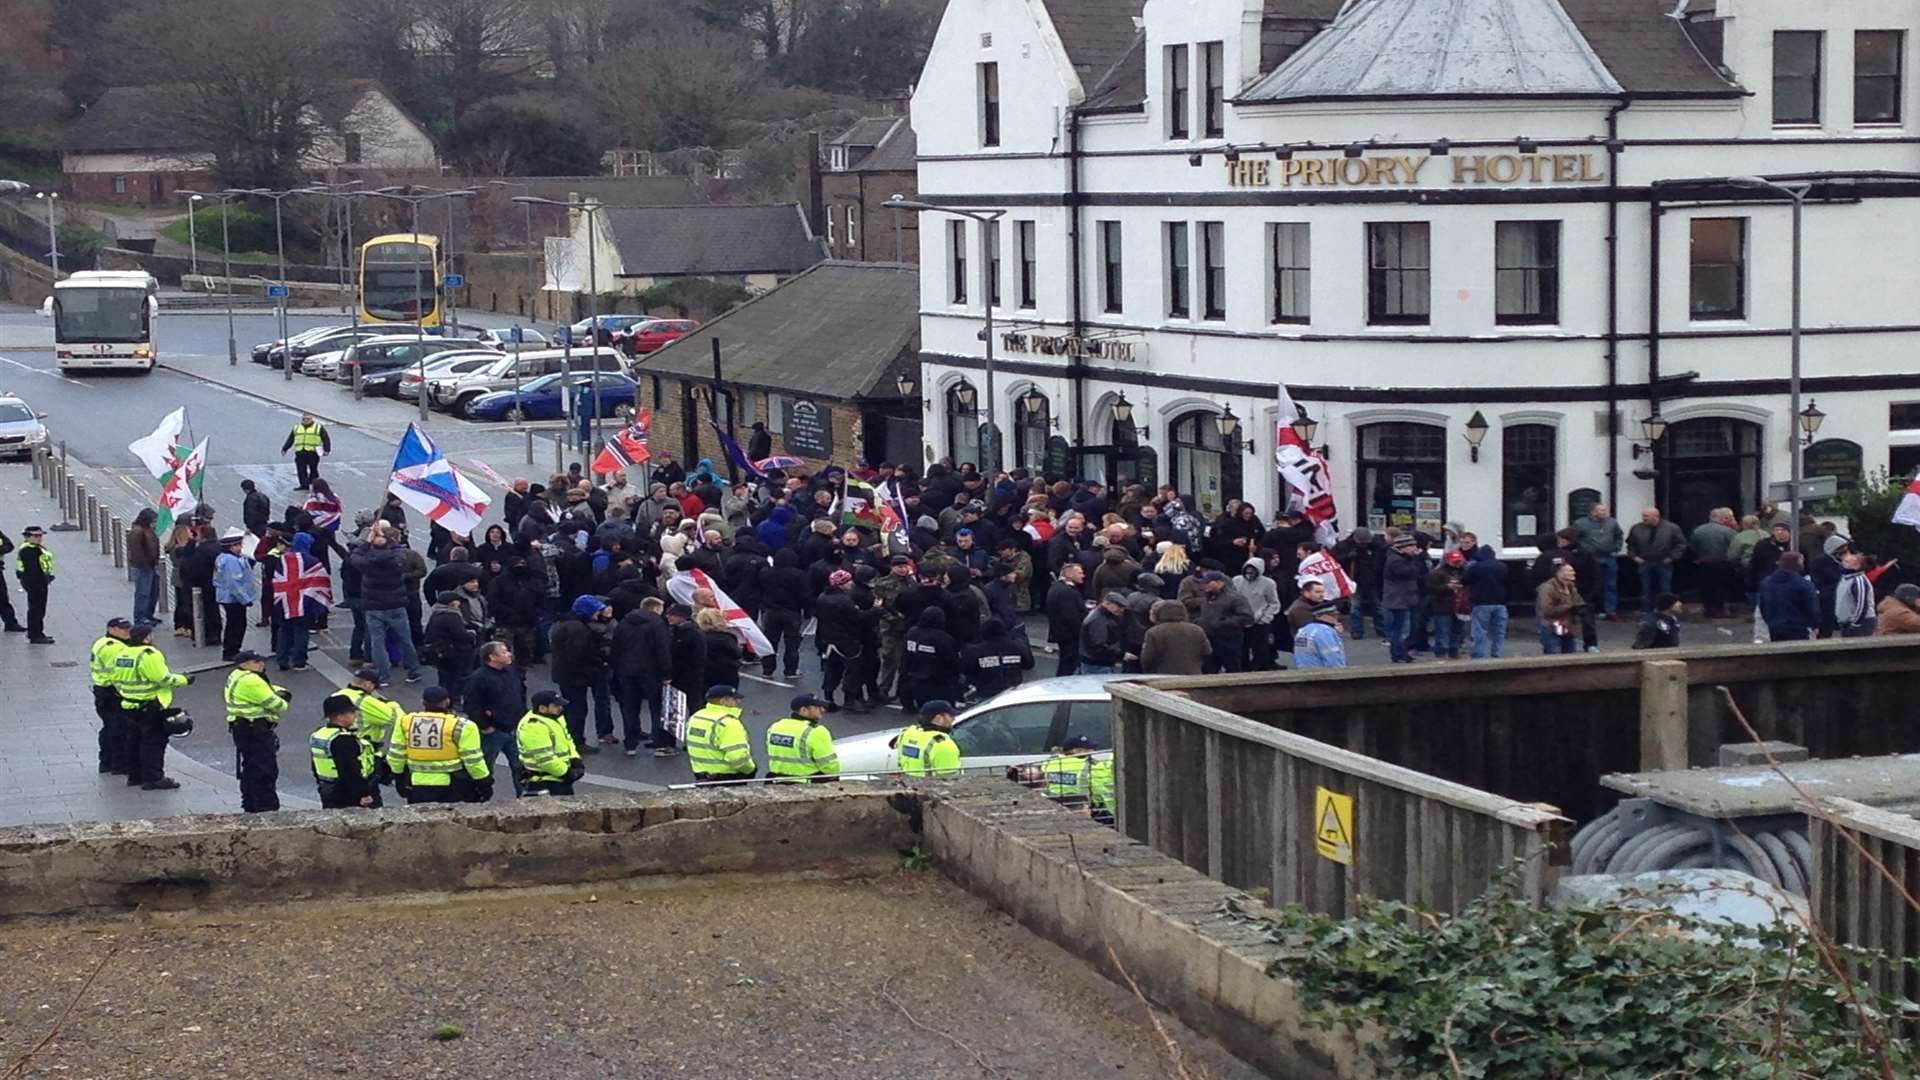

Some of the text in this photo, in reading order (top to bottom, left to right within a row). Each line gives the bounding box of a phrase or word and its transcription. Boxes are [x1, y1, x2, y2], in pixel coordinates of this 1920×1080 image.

[1225, 153, 1605, 187] THE PRIORY HOTEL
